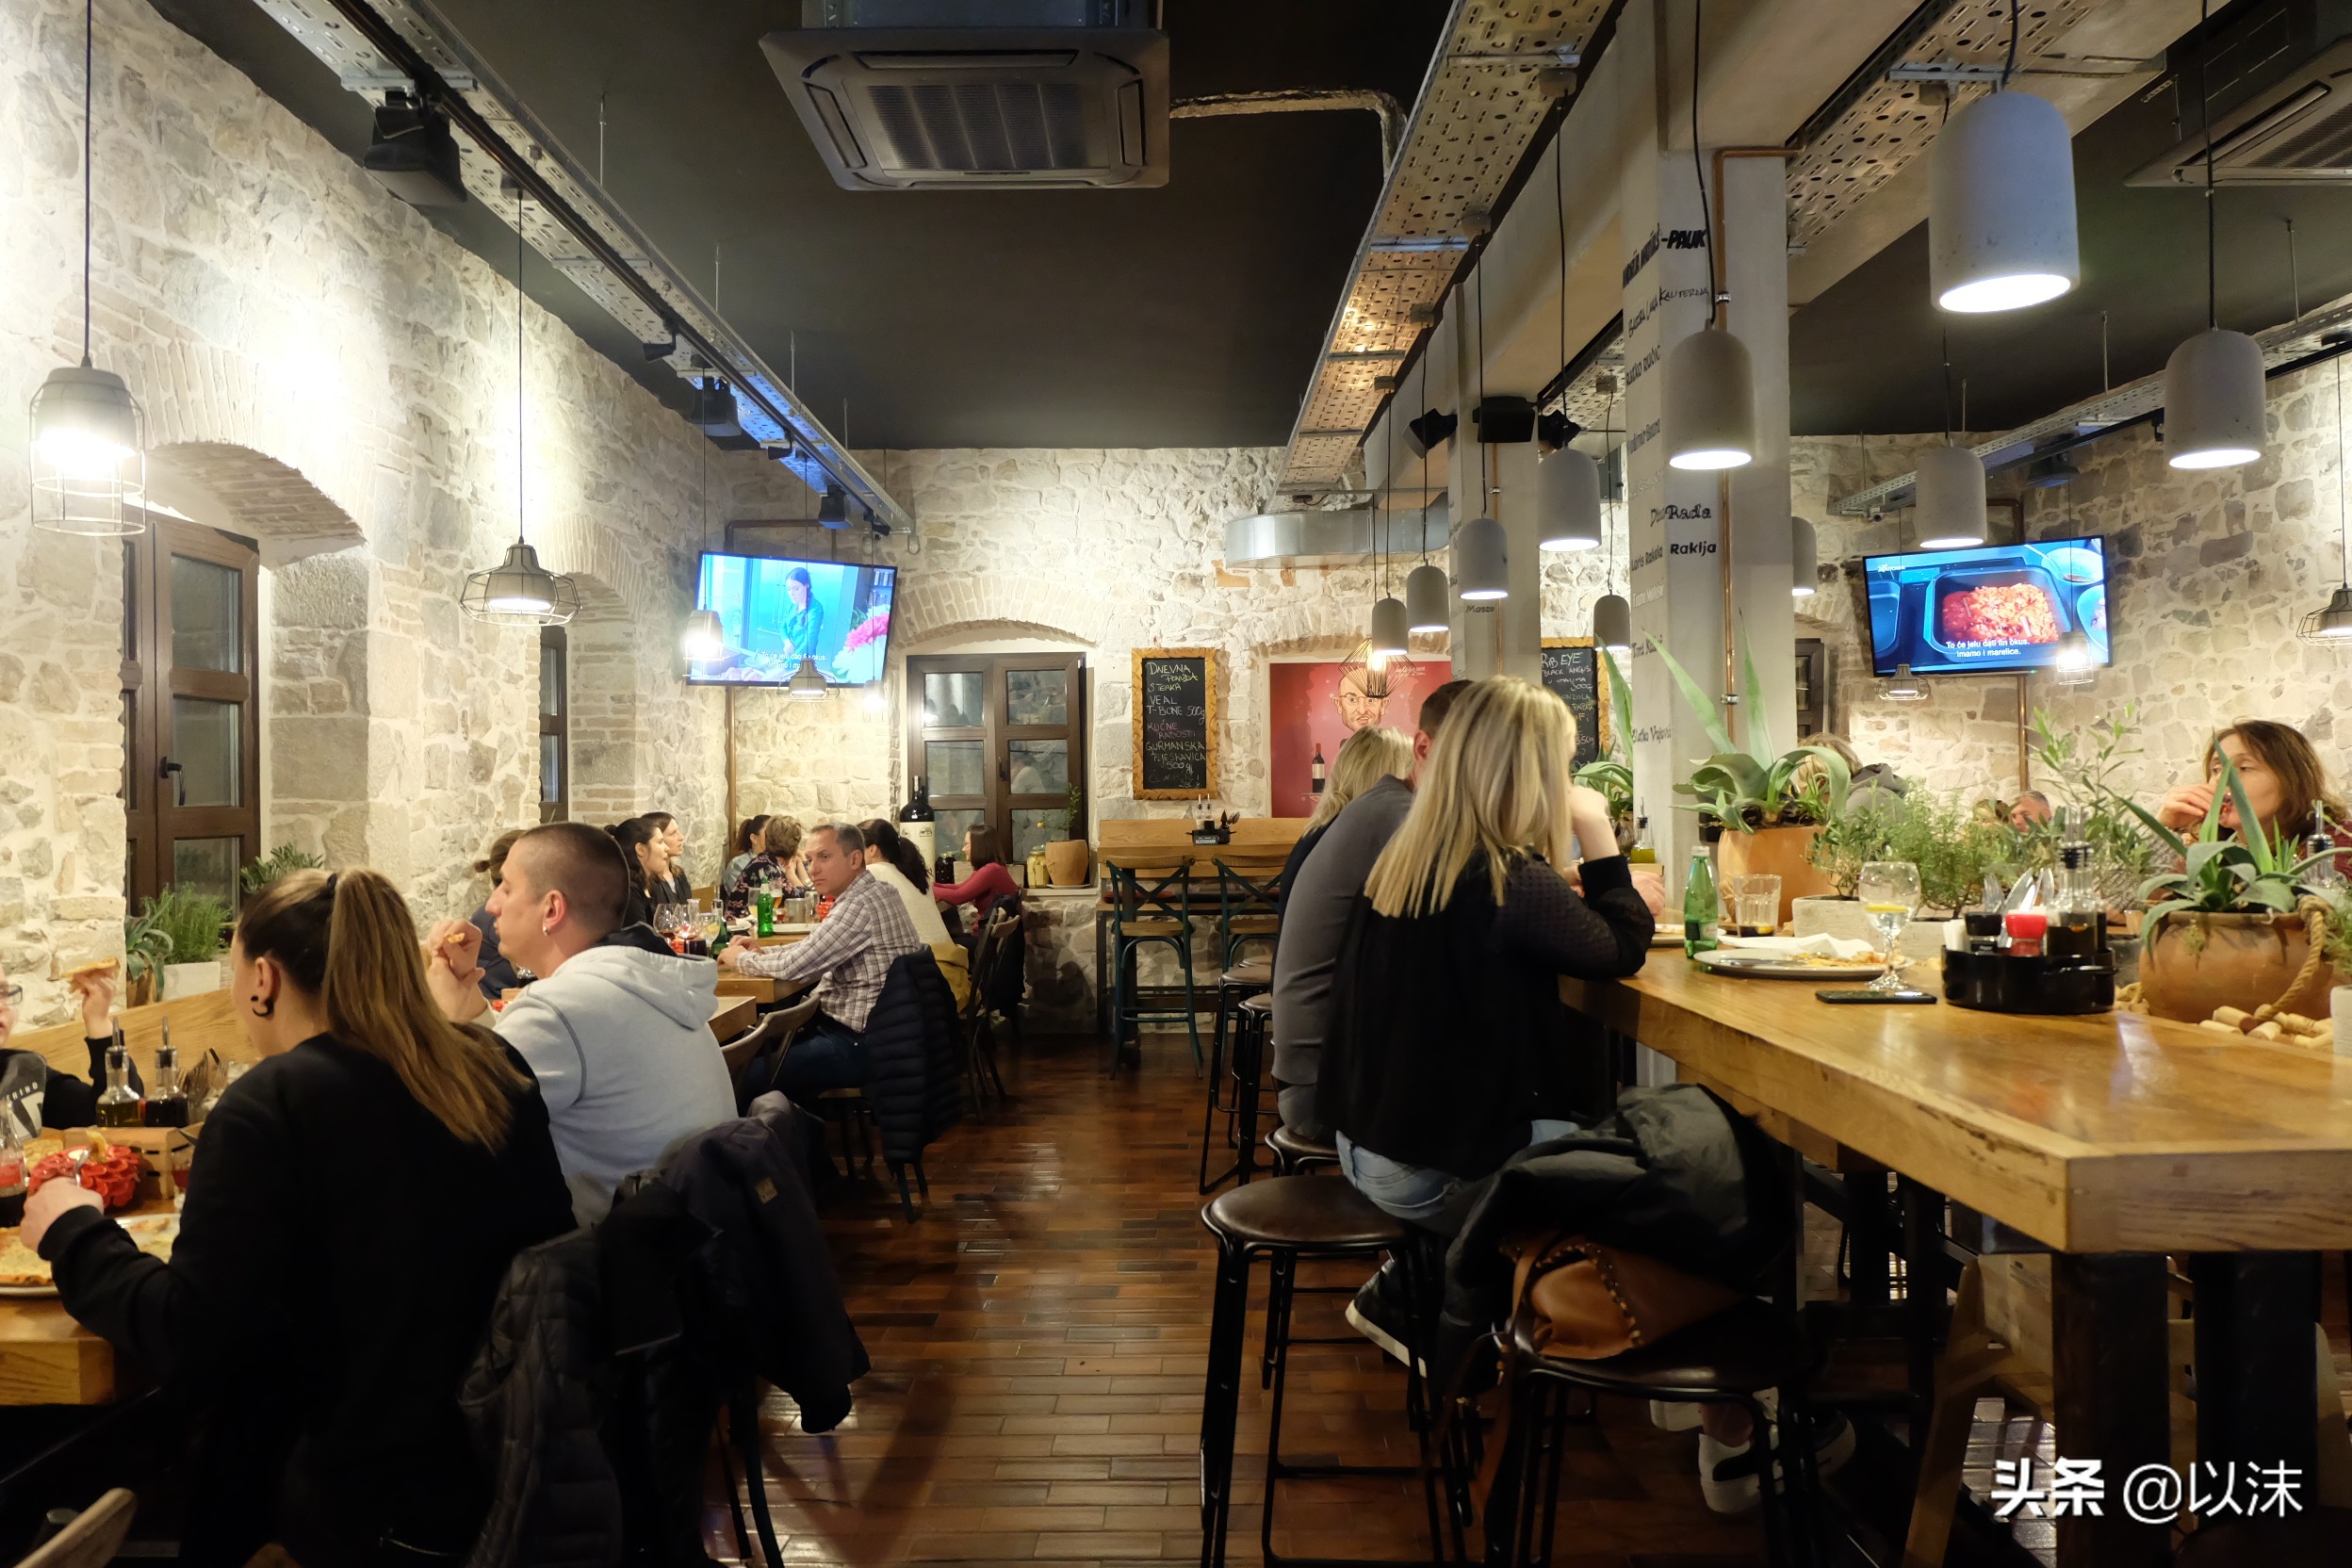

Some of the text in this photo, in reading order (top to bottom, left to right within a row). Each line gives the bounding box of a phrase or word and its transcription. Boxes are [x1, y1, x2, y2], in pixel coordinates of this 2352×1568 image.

[1670, 541, 1717, 557] Raklja
[1560, 651, 1584, 666] EYE
[1146, 662, 1192, 676] DNEVNA
[1150, 694, 1178, 706] VEAL
